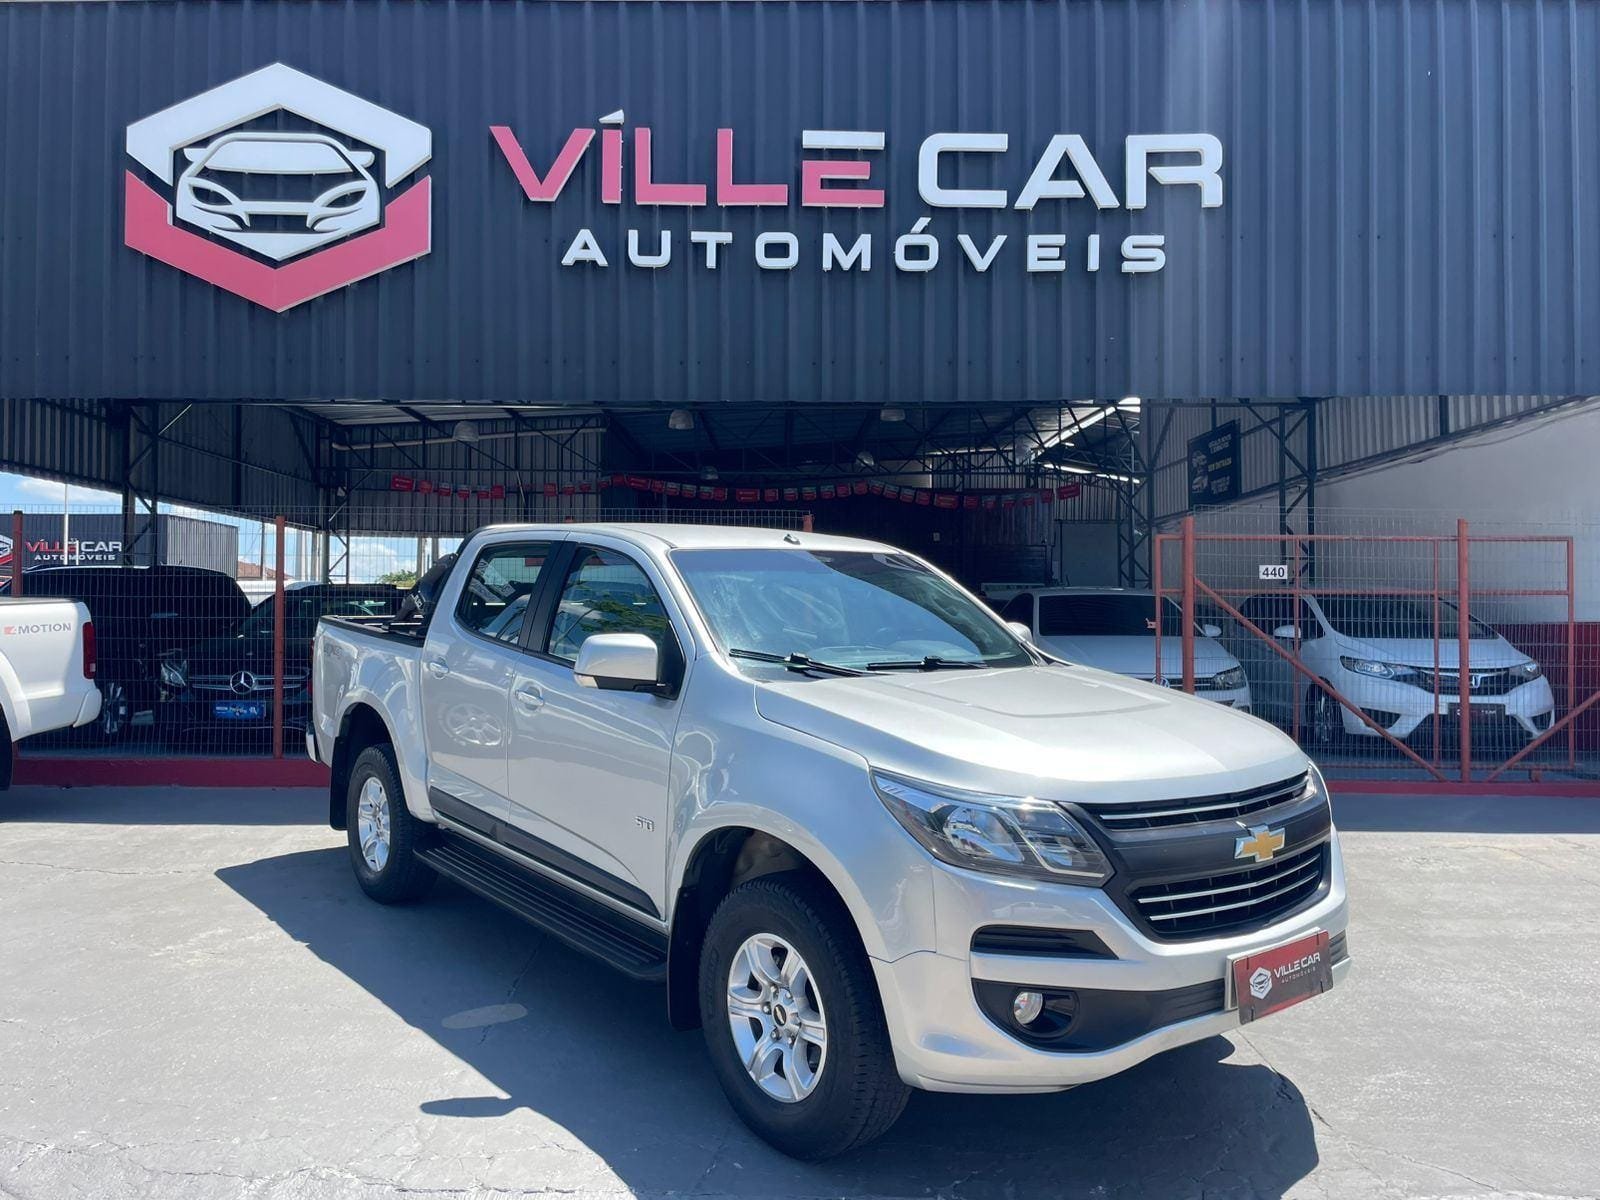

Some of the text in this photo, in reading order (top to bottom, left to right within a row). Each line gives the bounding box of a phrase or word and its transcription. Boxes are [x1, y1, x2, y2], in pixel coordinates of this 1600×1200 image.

[918, 132, 1223, 210] CAR
[560, 217, 1166, 273] AUTOMÓVEIS
[80, 541, 122, 552] CAR
[1262, 567, 1285, 578] 440
[1300, 952, 1320, 967] CAR
